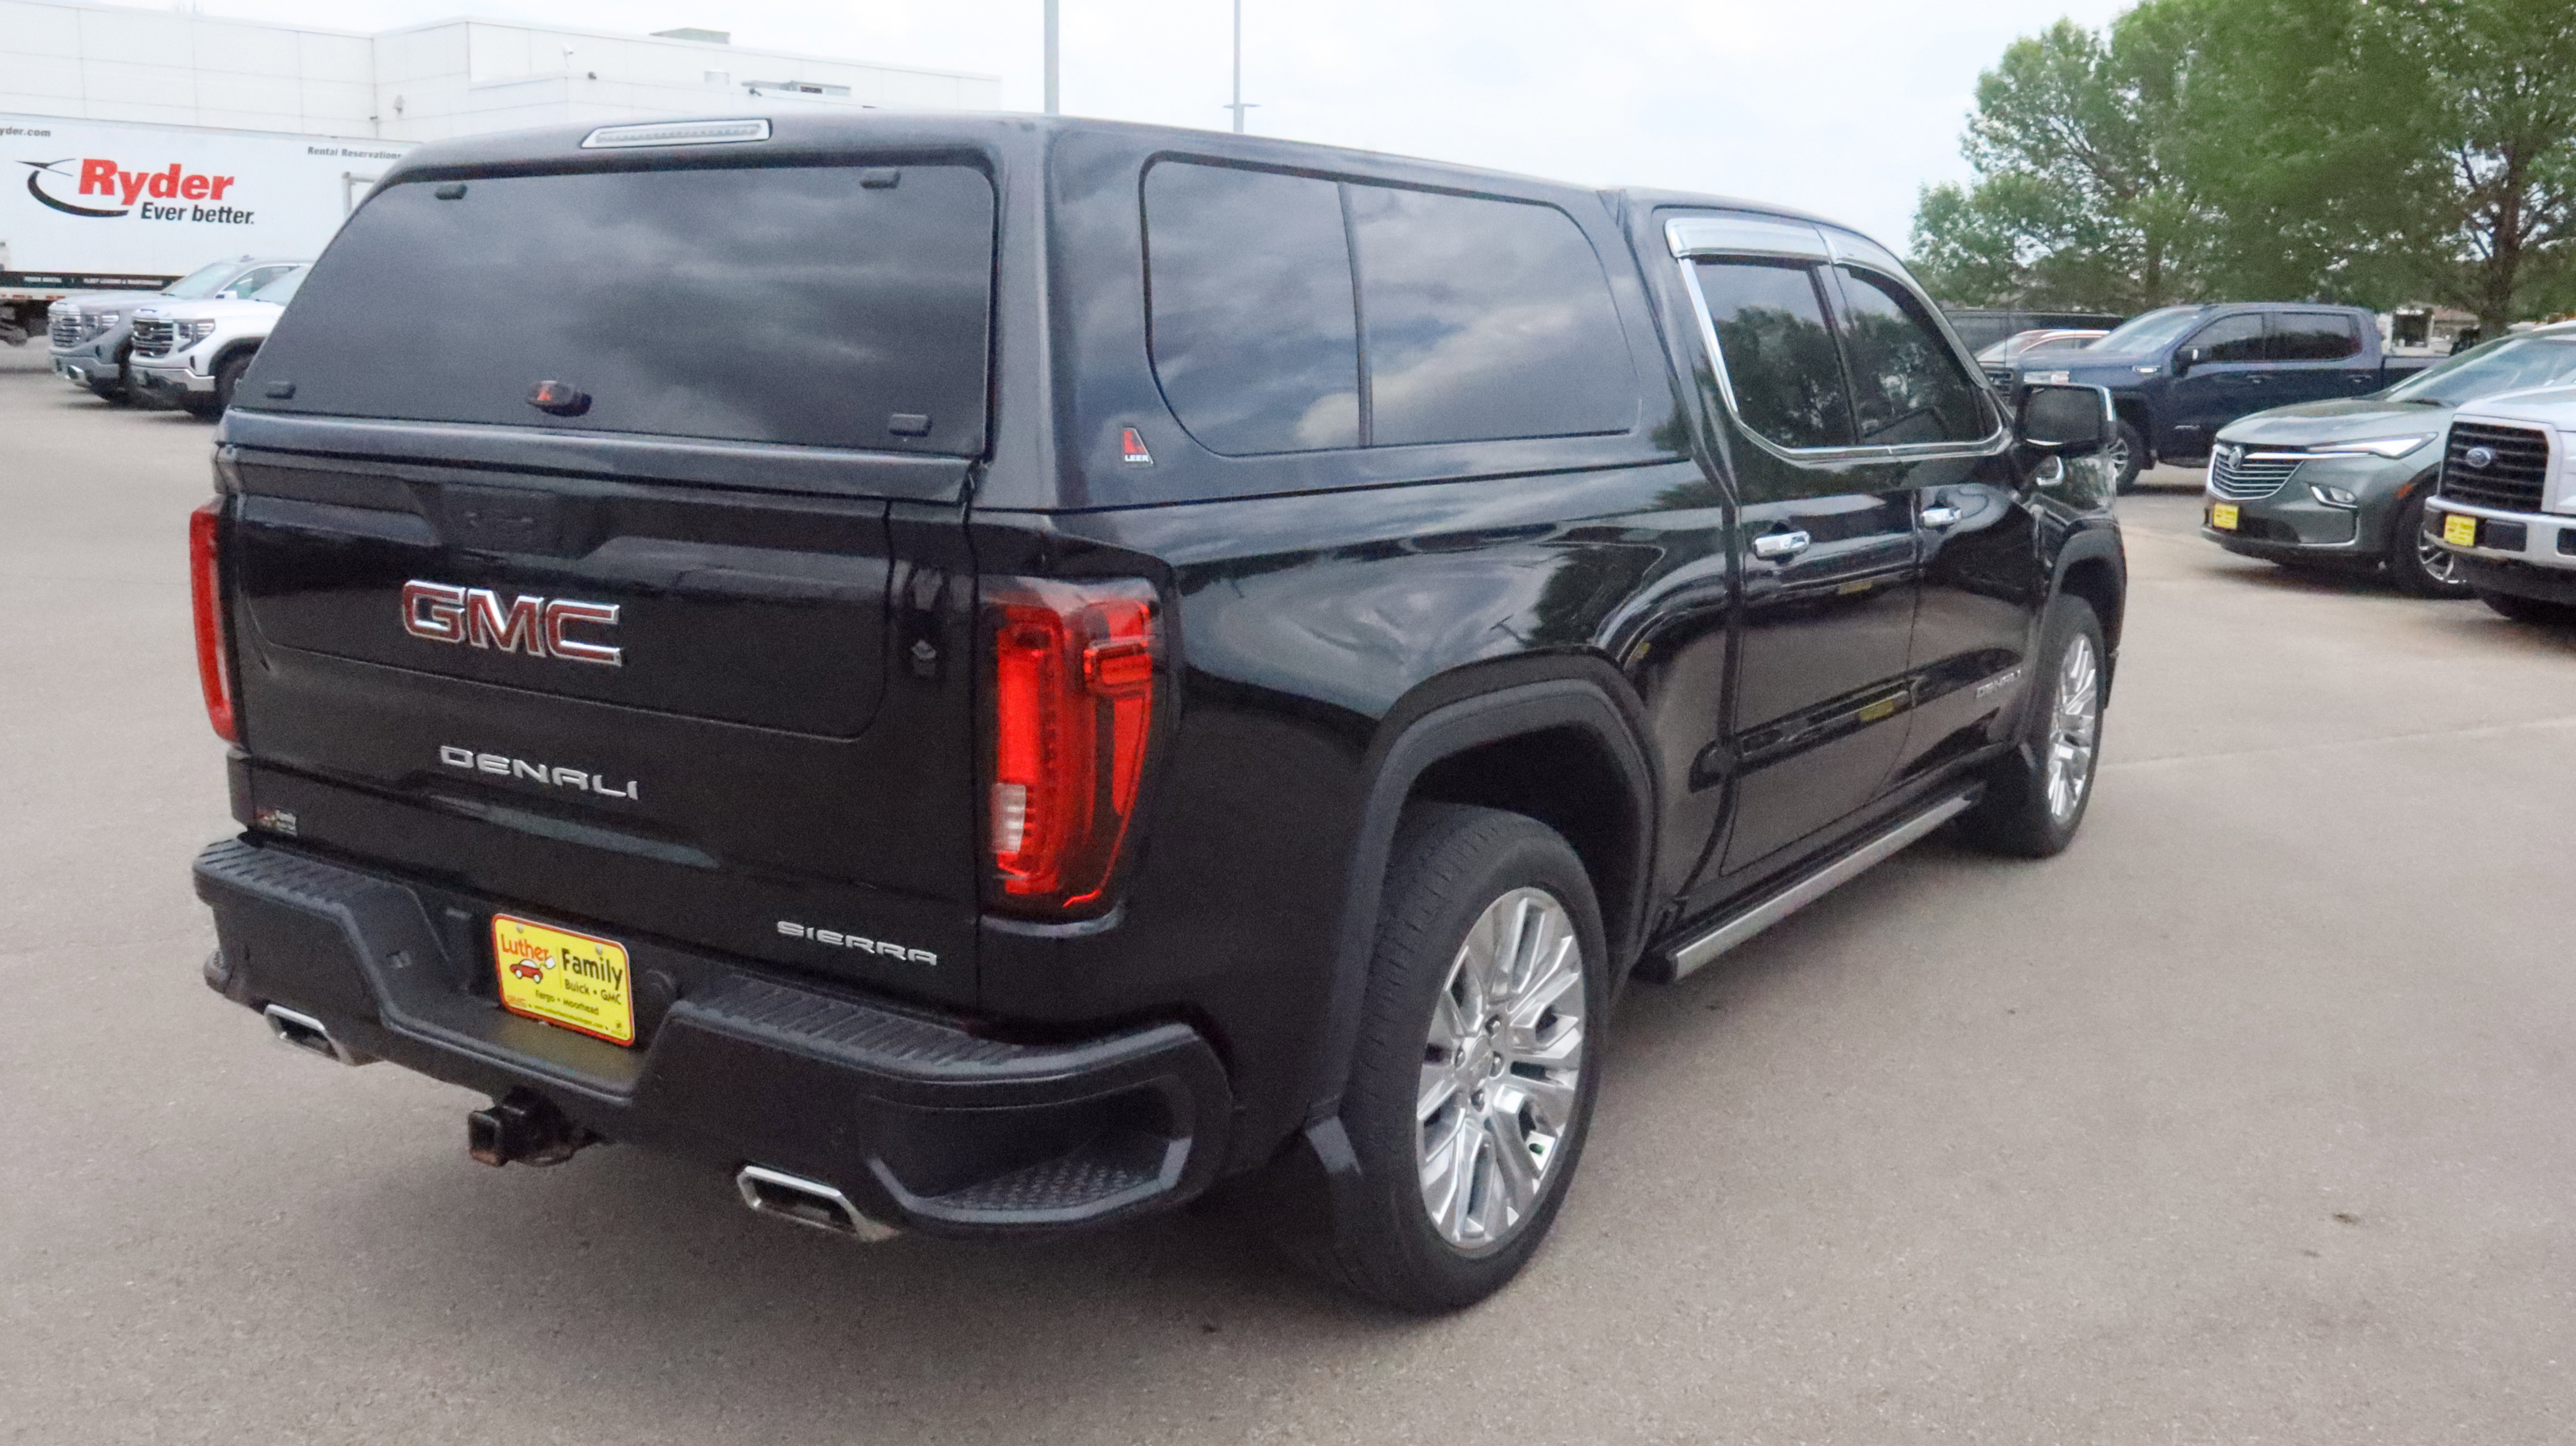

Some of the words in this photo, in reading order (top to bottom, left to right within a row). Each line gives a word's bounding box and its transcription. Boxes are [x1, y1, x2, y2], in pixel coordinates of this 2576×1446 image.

[308, 146, 338, 156] Rental
[79, 158, 235, 206] Ryder
[141, 201, 186, 221] Ever
[192, 204, 254, 225] better.
[402, 579, 622, 666] GMC
[440, 745, 638, 800] DENALI
[500, 933, 550, 961] Luther
[777, 921, 937, 966] SIERRA
[561, 947, 623, 991] Family
[564, 979, 590, 996] Buick
[601, 989, 622, 1005] GMC
